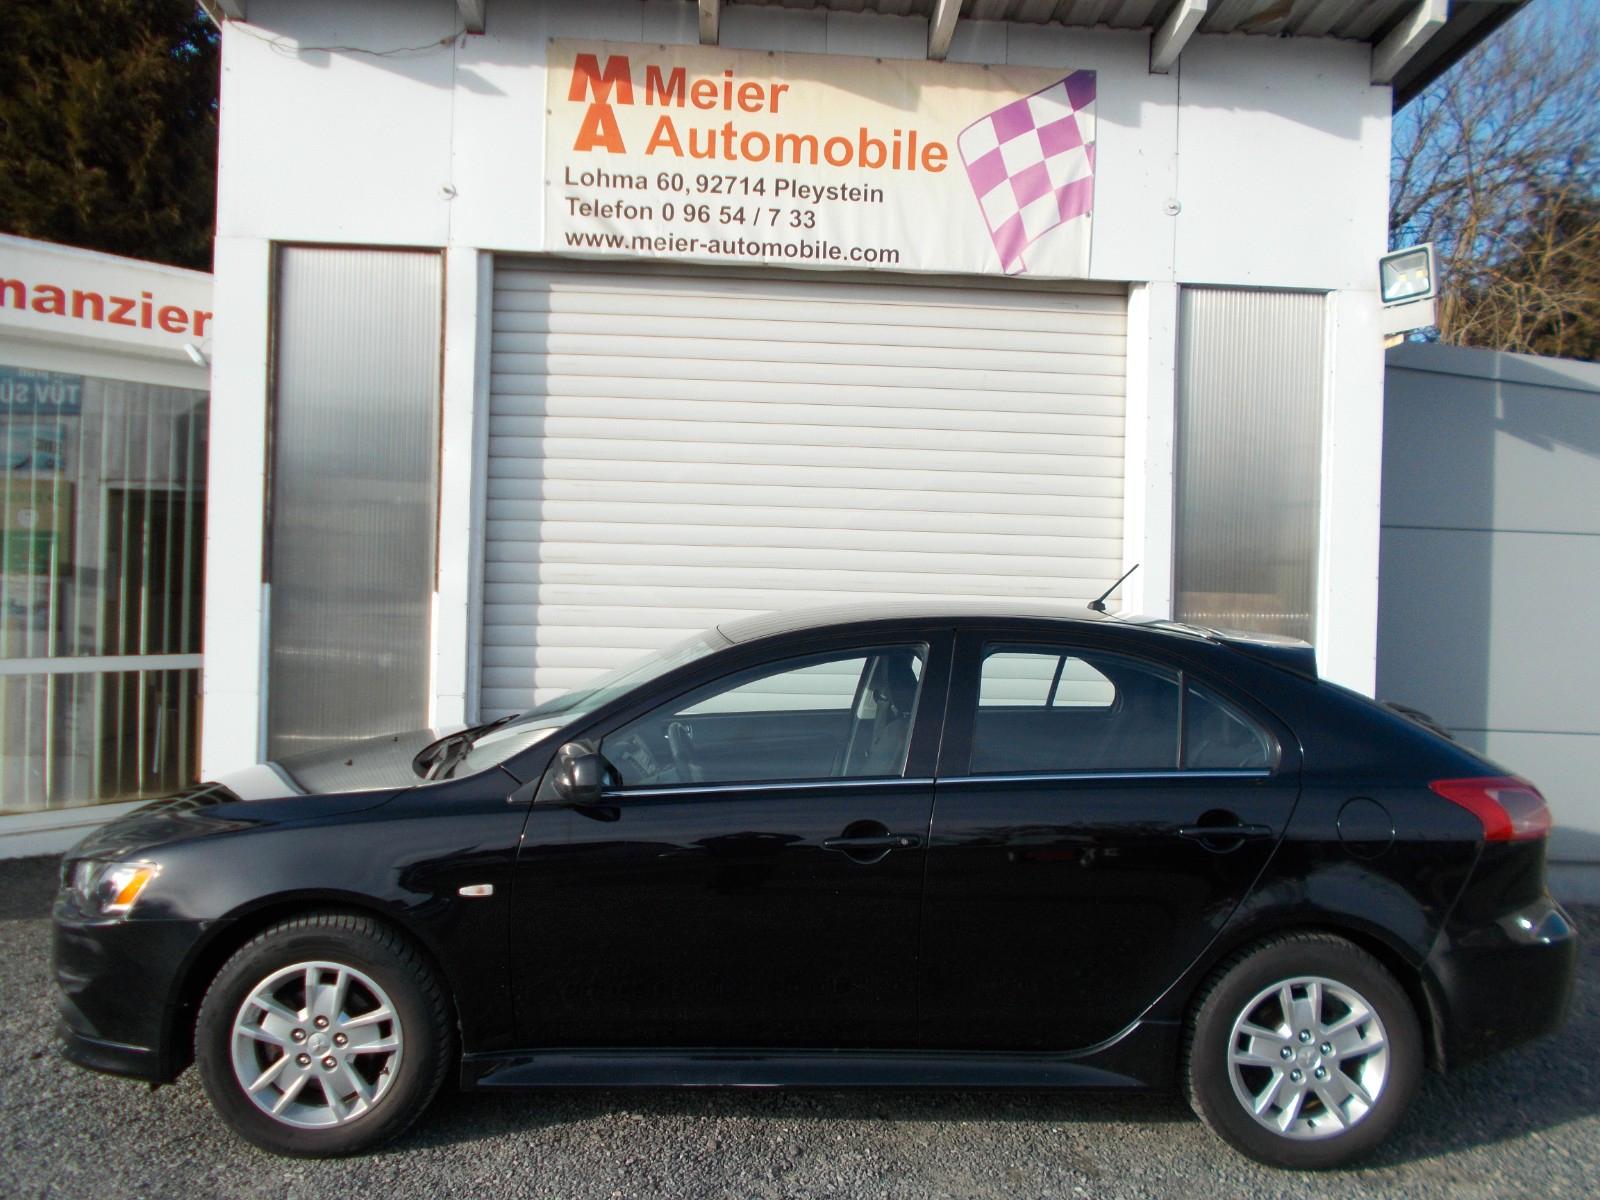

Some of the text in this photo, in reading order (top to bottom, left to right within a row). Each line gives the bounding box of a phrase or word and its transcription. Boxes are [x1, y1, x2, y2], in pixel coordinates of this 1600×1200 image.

[645, 65, 789, 113] Meier
[645, 115, 948, 172] Automobile
[565, 166, 647, 190] Lohma
[775, 178, 884, 204] Pleystein
[565, 196, 653, 220] Telefon
[662, 203, 674, 221] 0
[683, 204, 710, 223] 96
[719, 205, 746, 225] 54
[768, 208, 781, 226] 7
[789, 209, 816, 229] 33
[565, 231, 900, 263] www.meier-automobile.com
